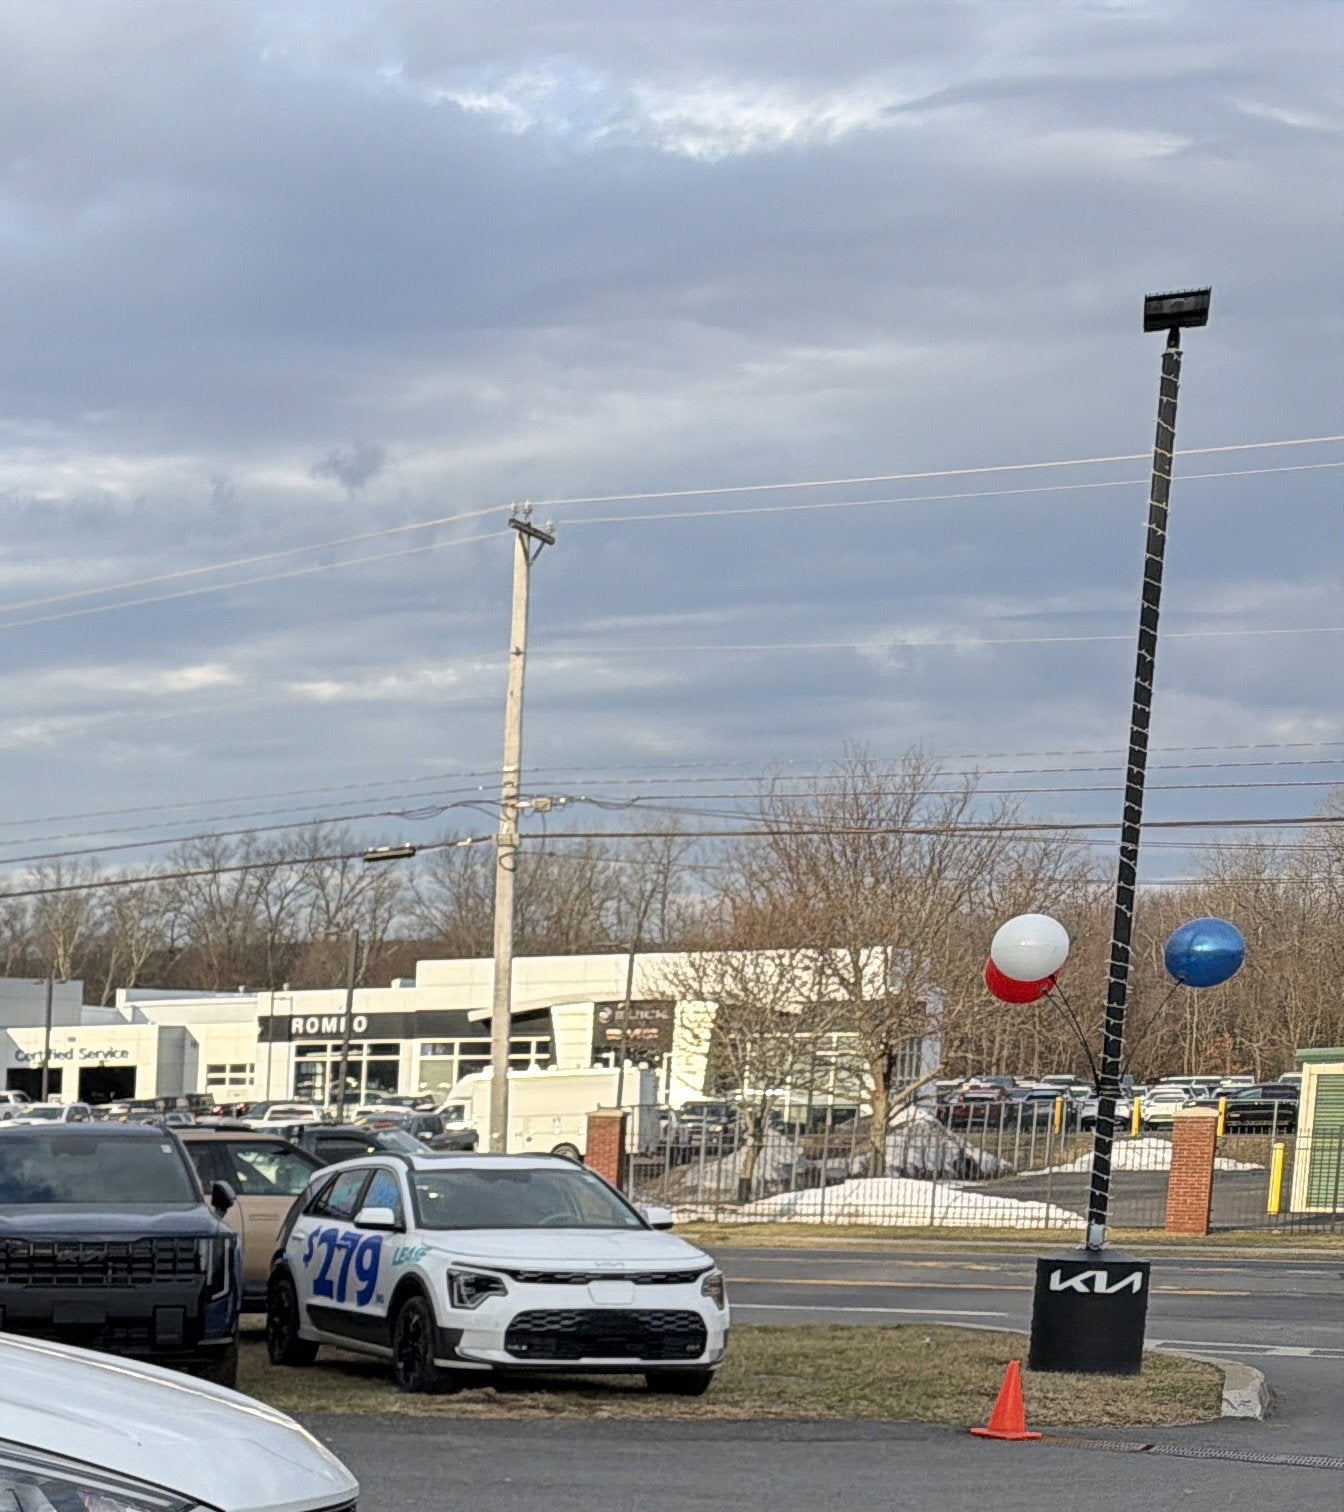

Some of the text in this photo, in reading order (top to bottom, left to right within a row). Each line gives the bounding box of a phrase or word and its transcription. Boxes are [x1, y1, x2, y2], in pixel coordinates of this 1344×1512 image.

[15, 1047, 129, 1062] Certfied Service
[1049, 1269, 1143, 1294] KIA
